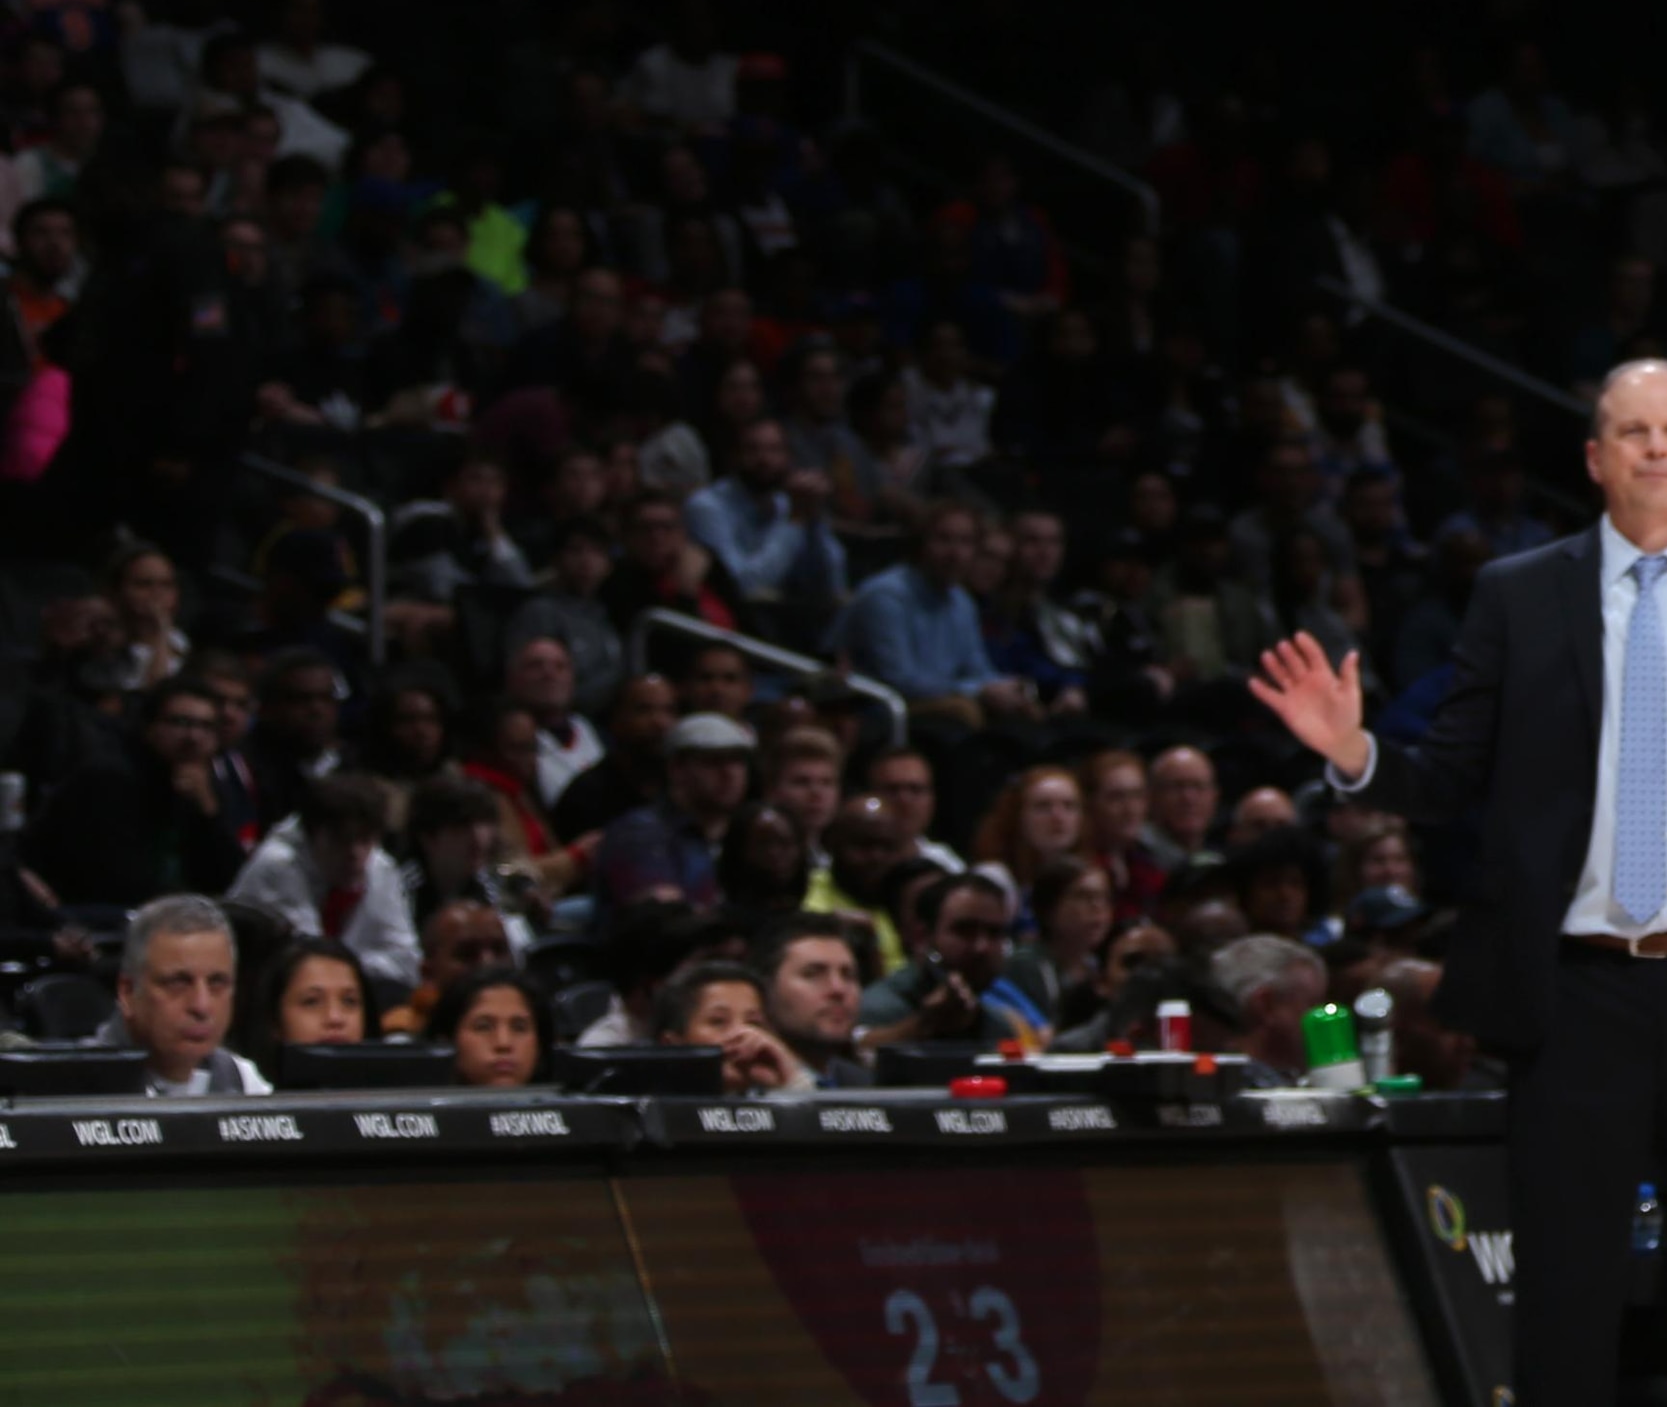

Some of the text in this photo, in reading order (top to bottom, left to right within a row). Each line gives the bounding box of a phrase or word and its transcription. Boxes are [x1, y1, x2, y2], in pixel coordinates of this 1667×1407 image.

[72, 1118, 164, 1146] WGL.COM
[218, 1114, 304, 1142] #ASKWGL
[352, 1113, 439, 1139] WGL.COM
[697, 1107, 776, 1132] WGL.COM
